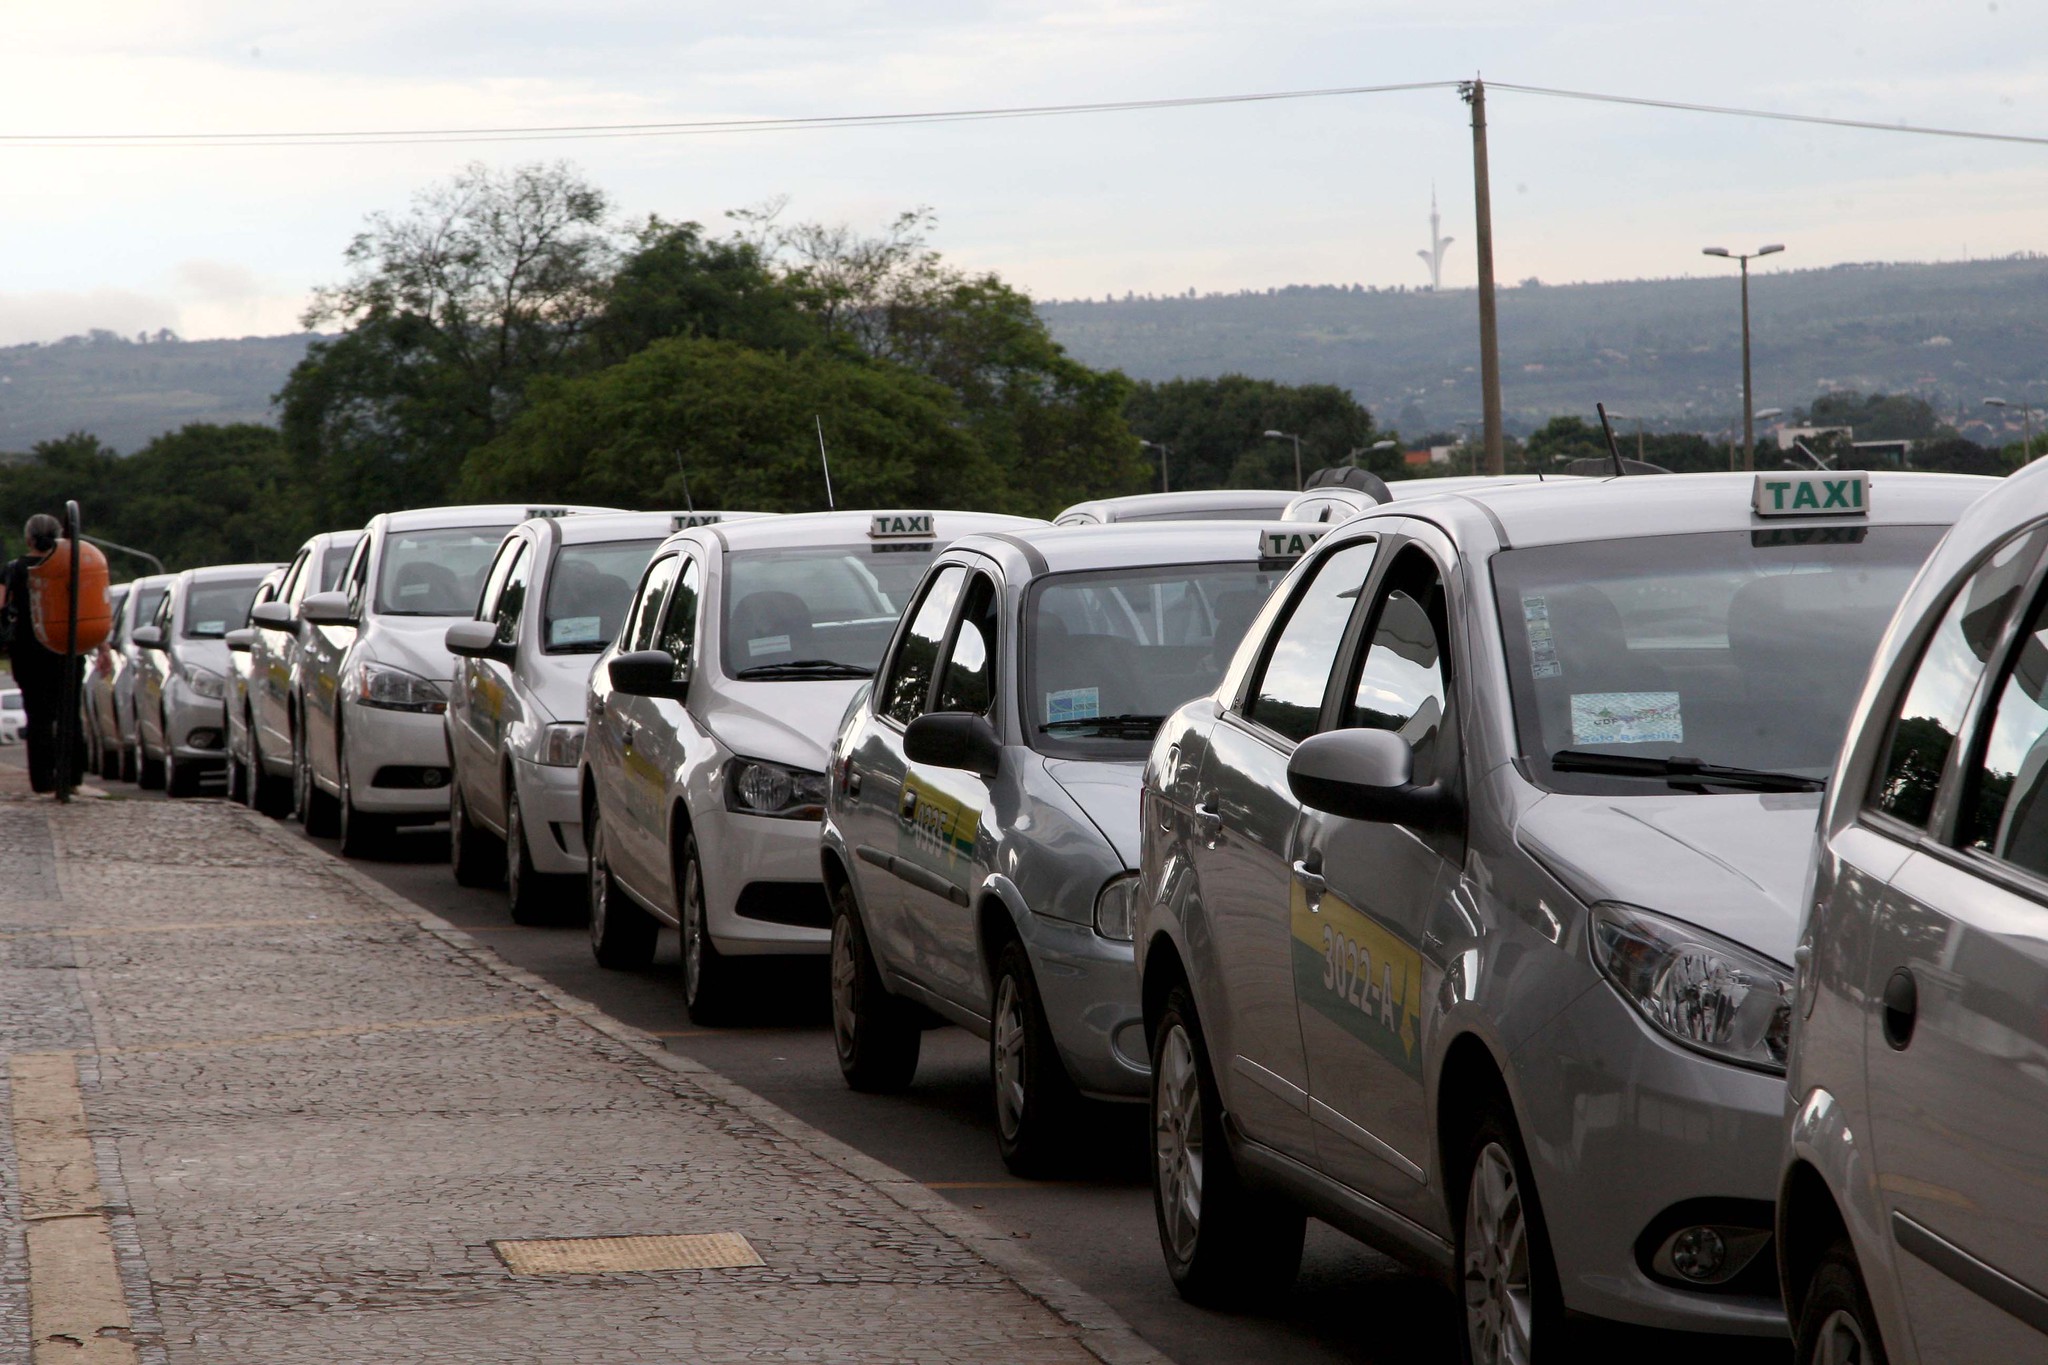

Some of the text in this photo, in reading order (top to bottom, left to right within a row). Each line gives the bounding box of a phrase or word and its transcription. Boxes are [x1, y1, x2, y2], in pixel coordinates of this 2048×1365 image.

[1765, 480, 1863, 510] TAXI
[876, 516, 930, 533] TAXI
[1323, 923, 1395, 1033] 3022-A
